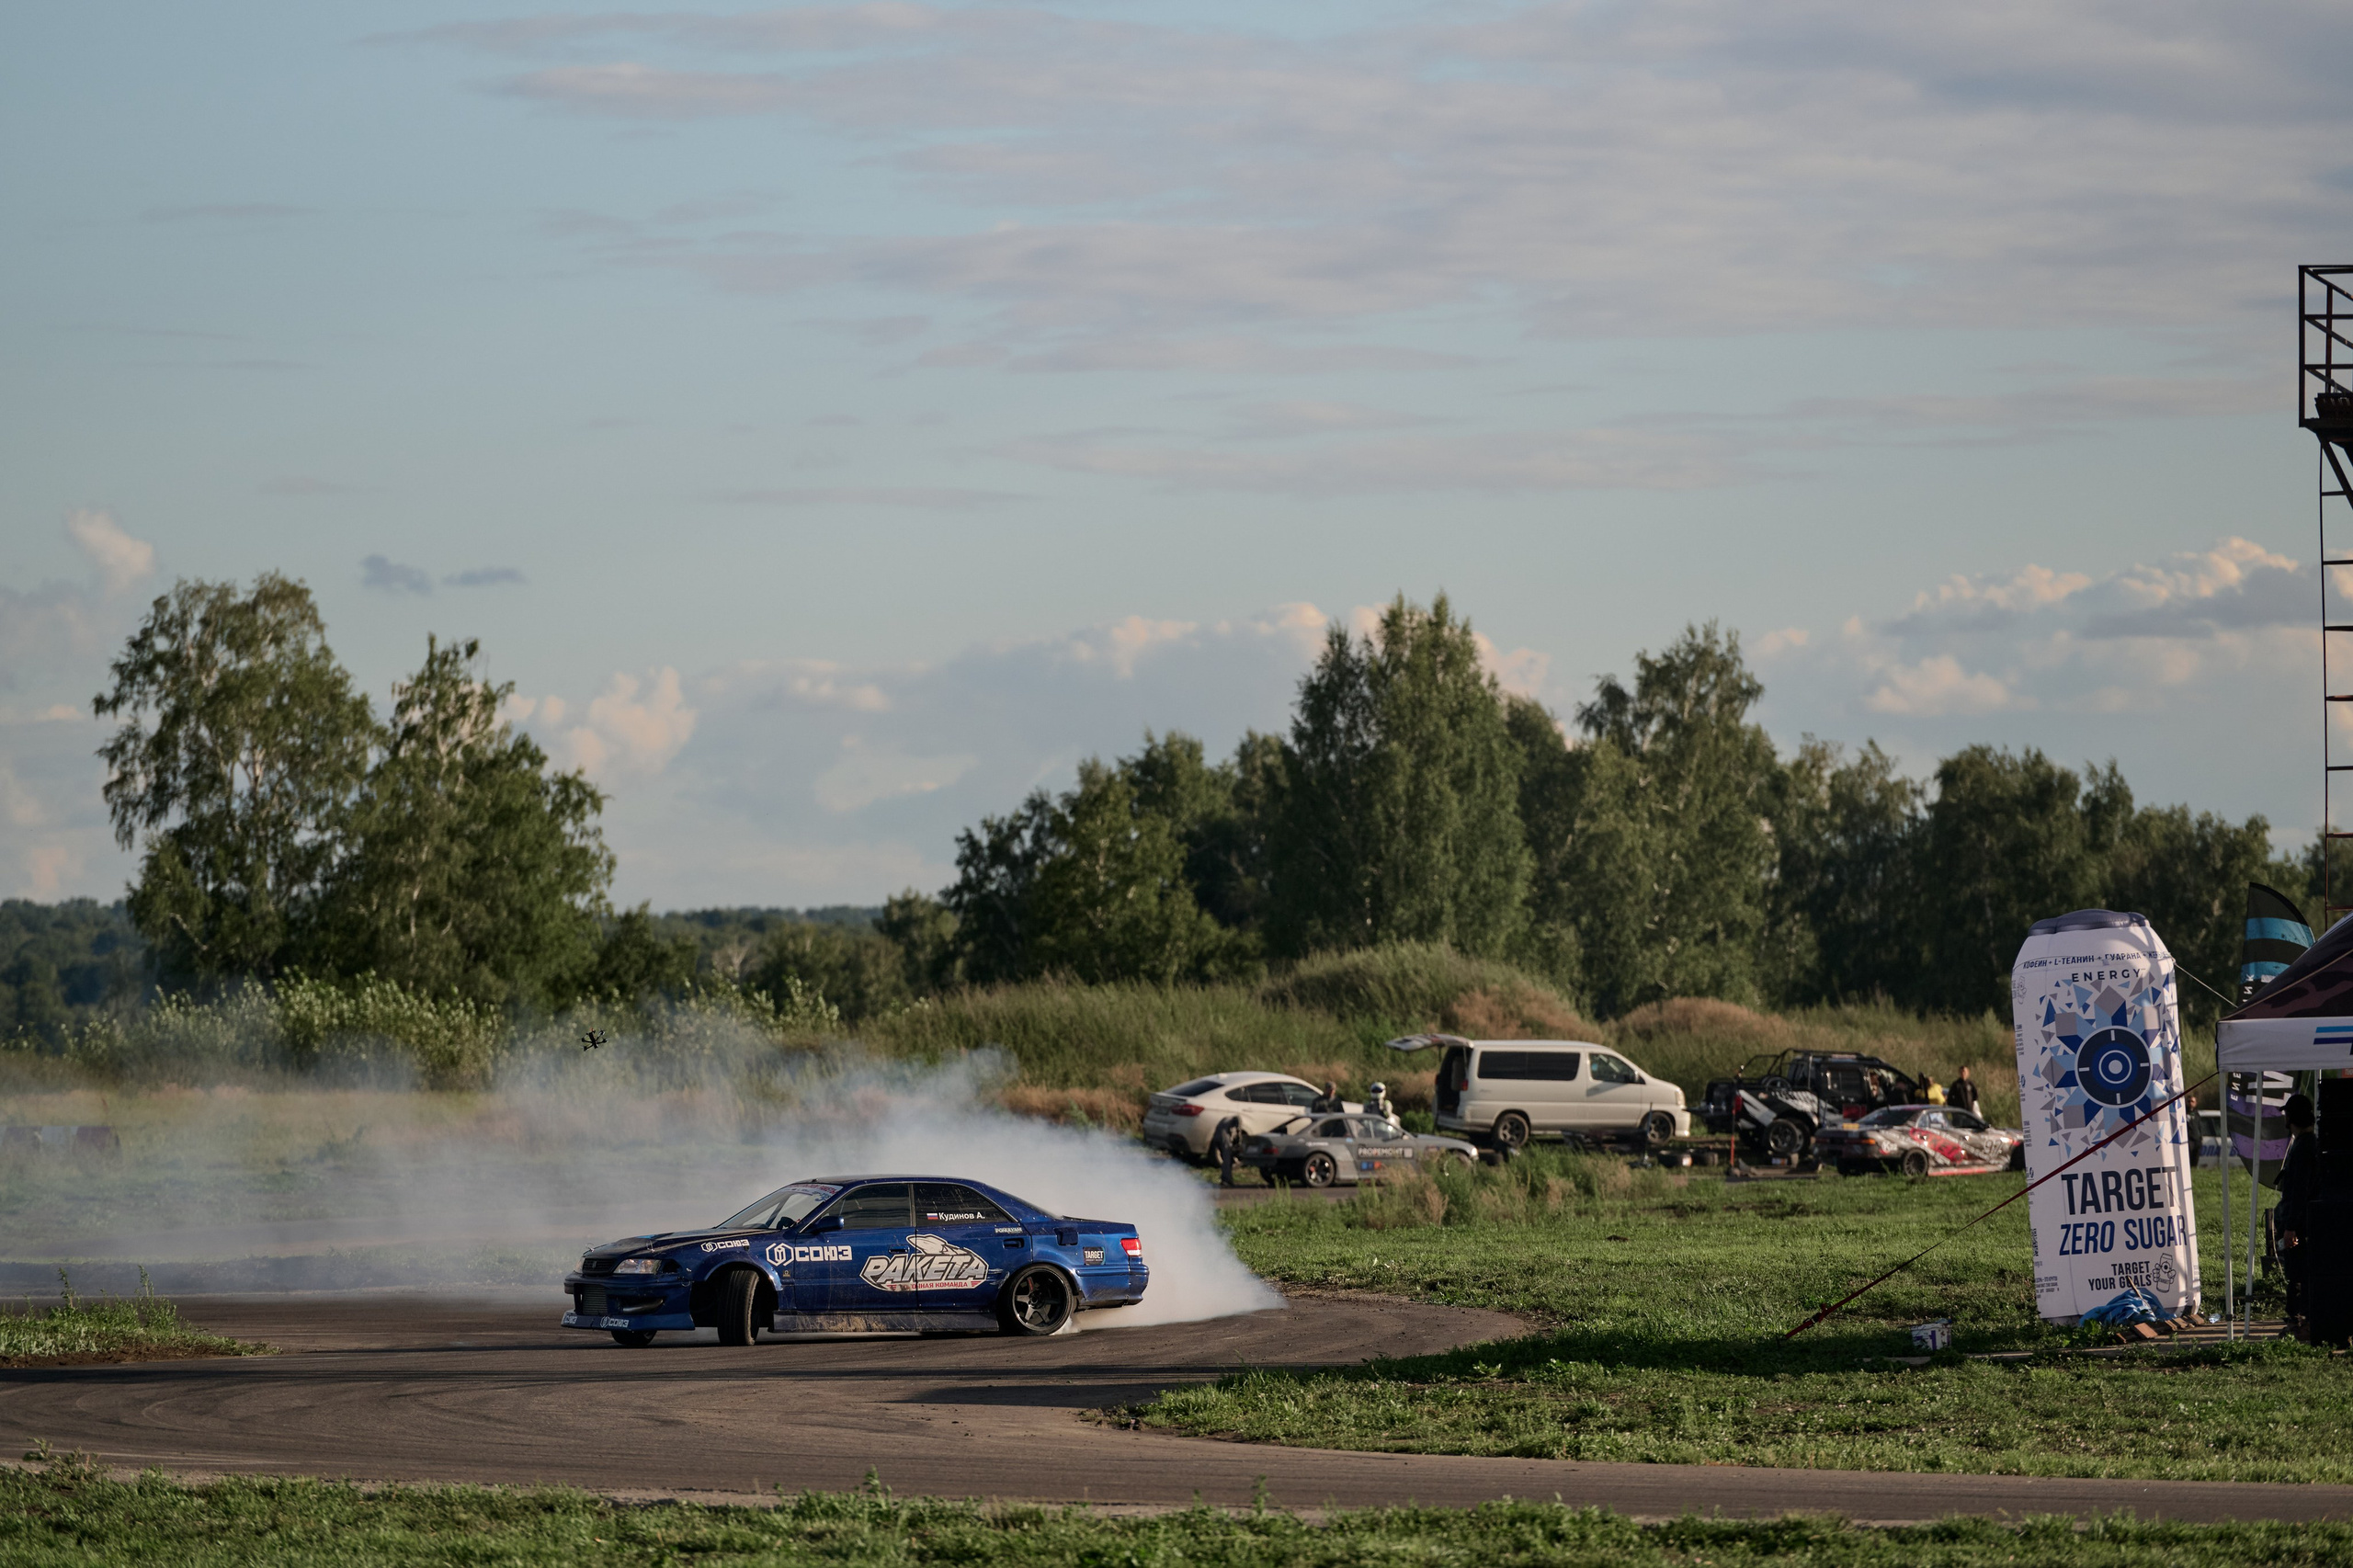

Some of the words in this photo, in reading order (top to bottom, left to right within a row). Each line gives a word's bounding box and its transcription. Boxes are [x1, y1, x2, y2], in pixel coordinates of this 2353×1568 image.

[2022, 960, 2047, 969] КОФЕИН
[2054, 955, 2095, 966] L-ТЕАНИН
[2105, 952, 2142, 961] ГУАРАНА
[2072, 969, 2141, 983] ENERGY
[2061, 1165, 2177, 1216] TARGET
[938, 1211, 975, 1221] Кудинов
[976, 1211, 985, 1220] А.
[2059, 1220, 2116, 1256] ZERO
[2123, 1214, 2188, 1251] SUGAR
[717, 1239, 750, 1249] СОЮЗ
[794, 1244, 853, 1262] СОЮЗ
[1084, 1250, 1104, 1259] TARGET
[865, 1252, 988, 1284] РАКЕТА
[2111, 1260, 2151, 1276] TARGET
[2088, 1277, 2116, 1291] YOUR
[2119, 1274, 2152, 1289] GOALS
